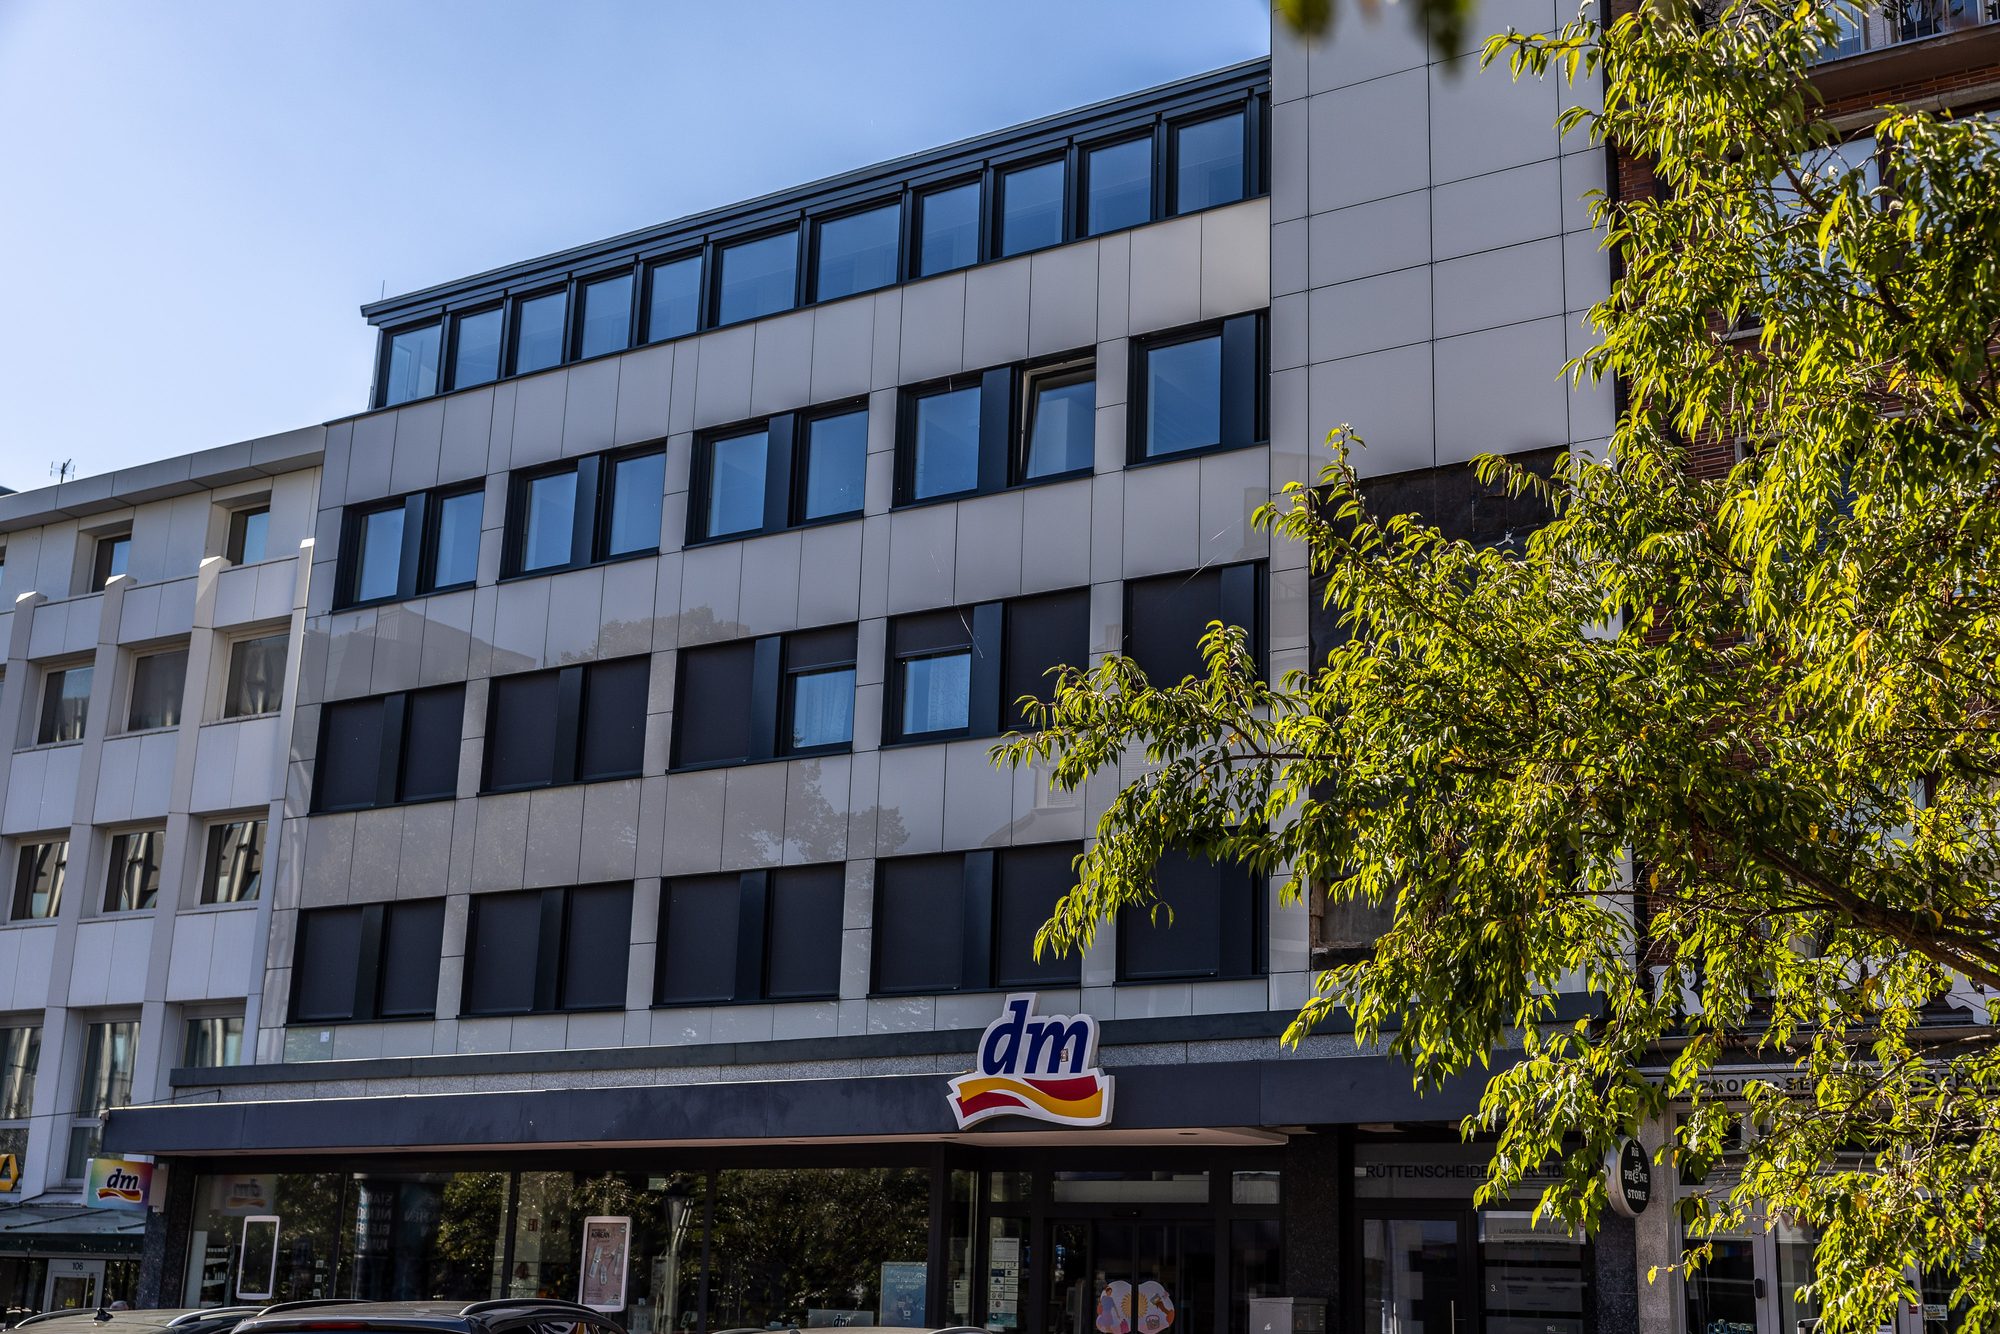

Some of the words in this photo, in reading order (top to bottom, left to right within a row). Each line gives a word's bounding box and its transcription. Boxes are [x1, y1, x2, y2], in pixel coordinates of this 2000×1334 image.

[982, 999, 1089, 1076] dm
[1366, 1163, 1500, 1178] RÜTTENSCHEIDE
[106, 1168, 139, 1190] dm
[1627, 1189, 1647, 1201] STORE
[72, 1262, 84, 1271] 106
